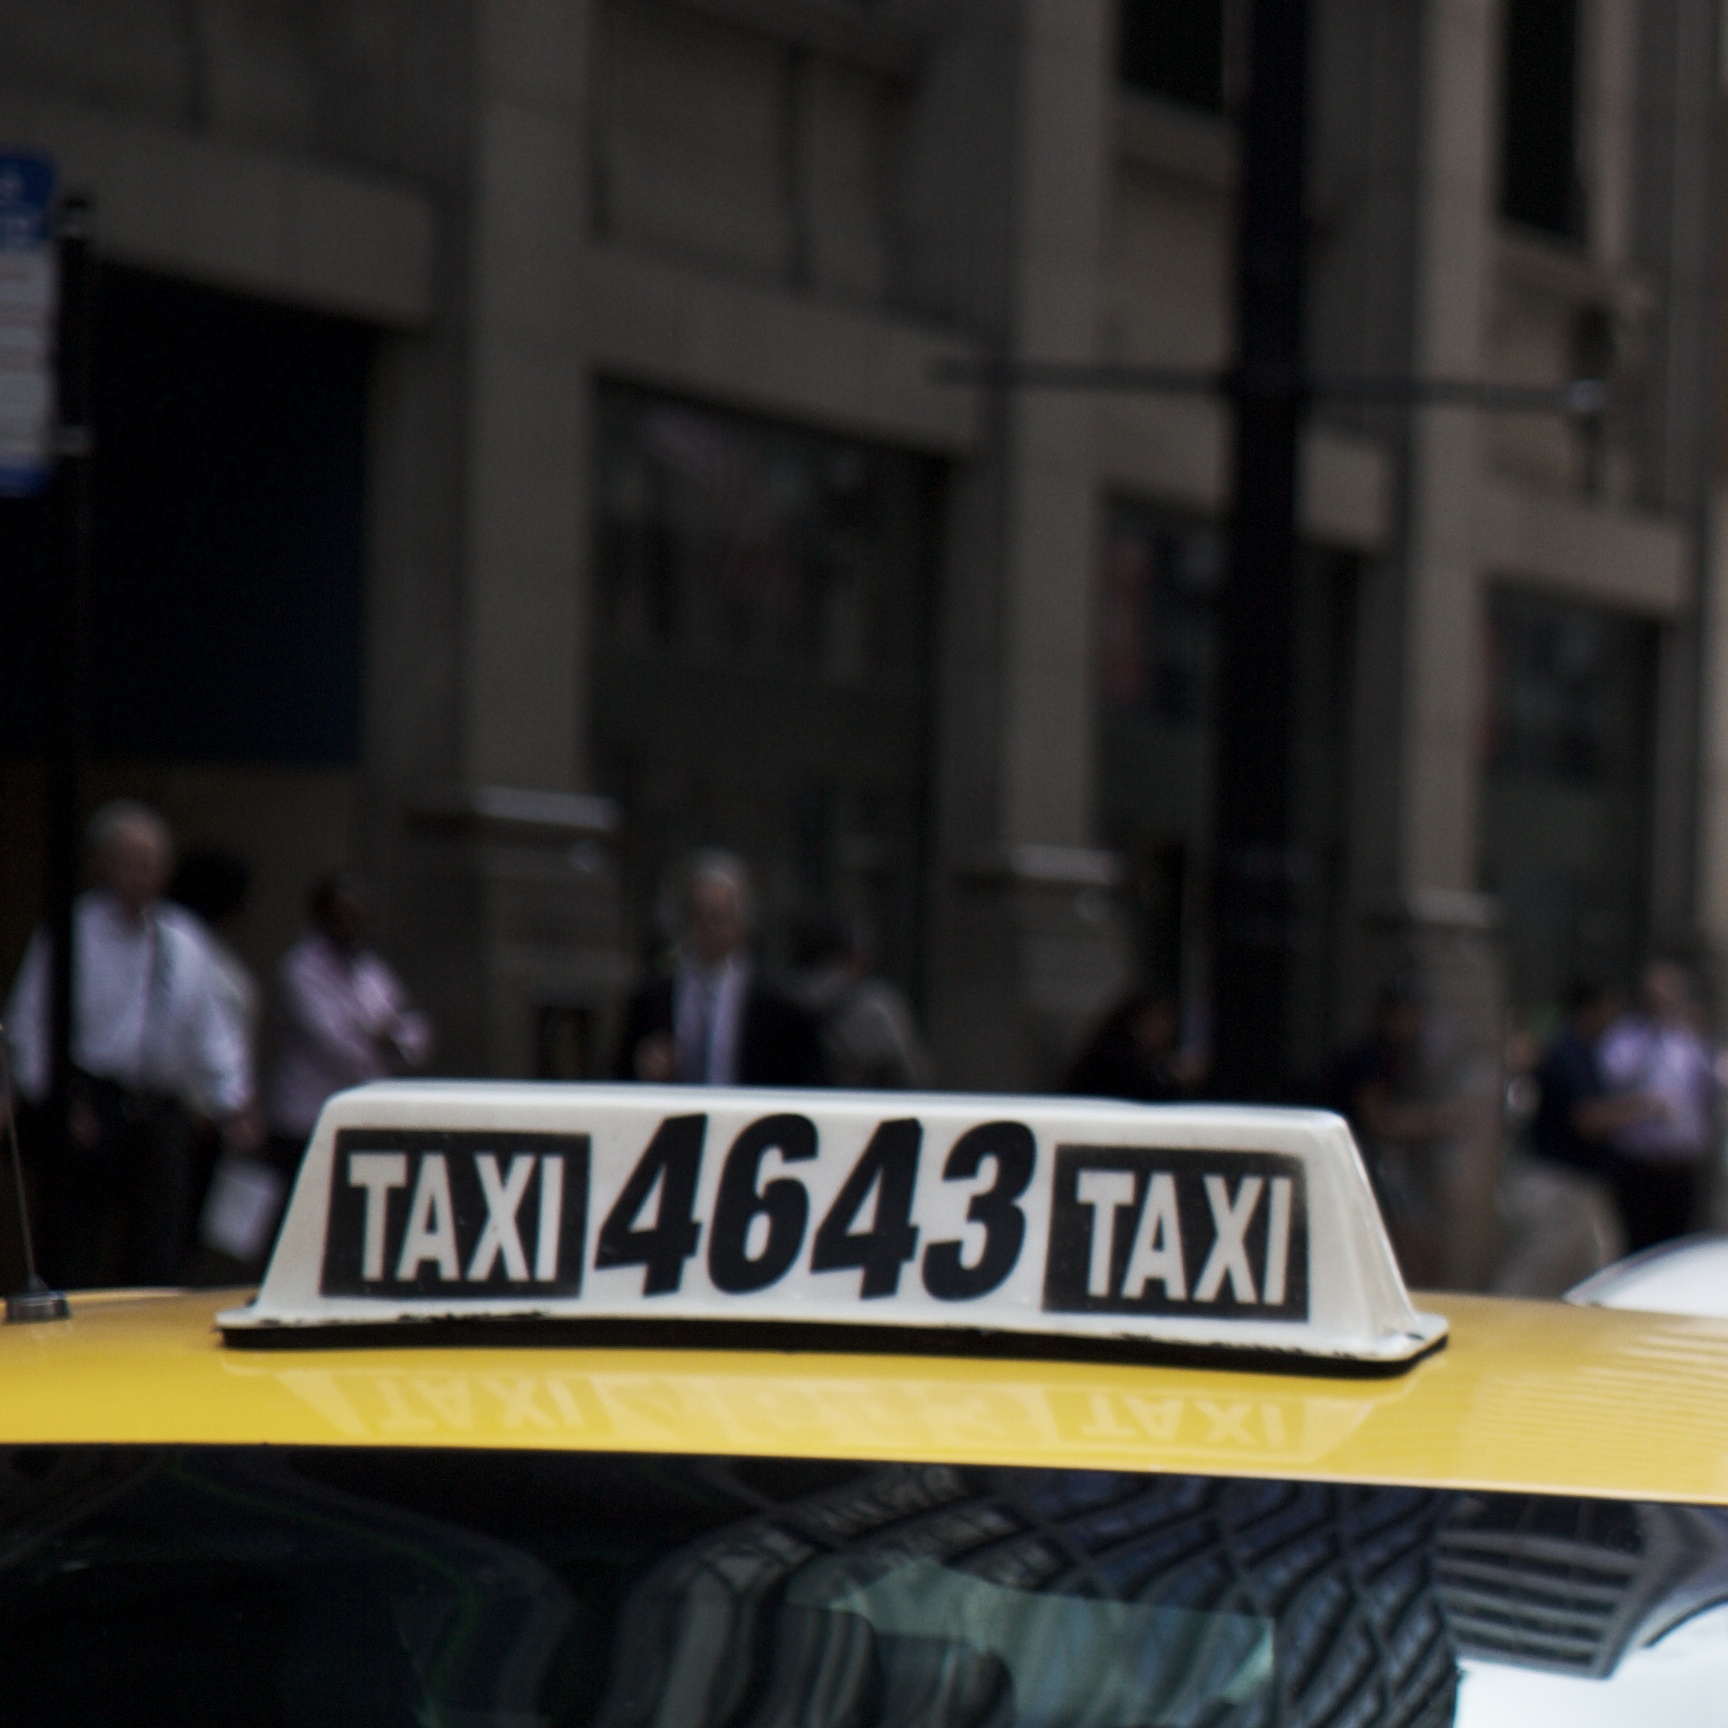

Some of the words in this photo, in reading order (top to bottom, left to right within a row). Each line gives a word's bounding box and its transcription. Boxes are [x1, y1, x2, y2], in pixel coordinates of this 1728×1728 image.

[348, 1152, 564, 1282] TAXI
[594, 1112, 1037, 1301] 4643
[1076, 1169, 1293, 1306] TAXI
